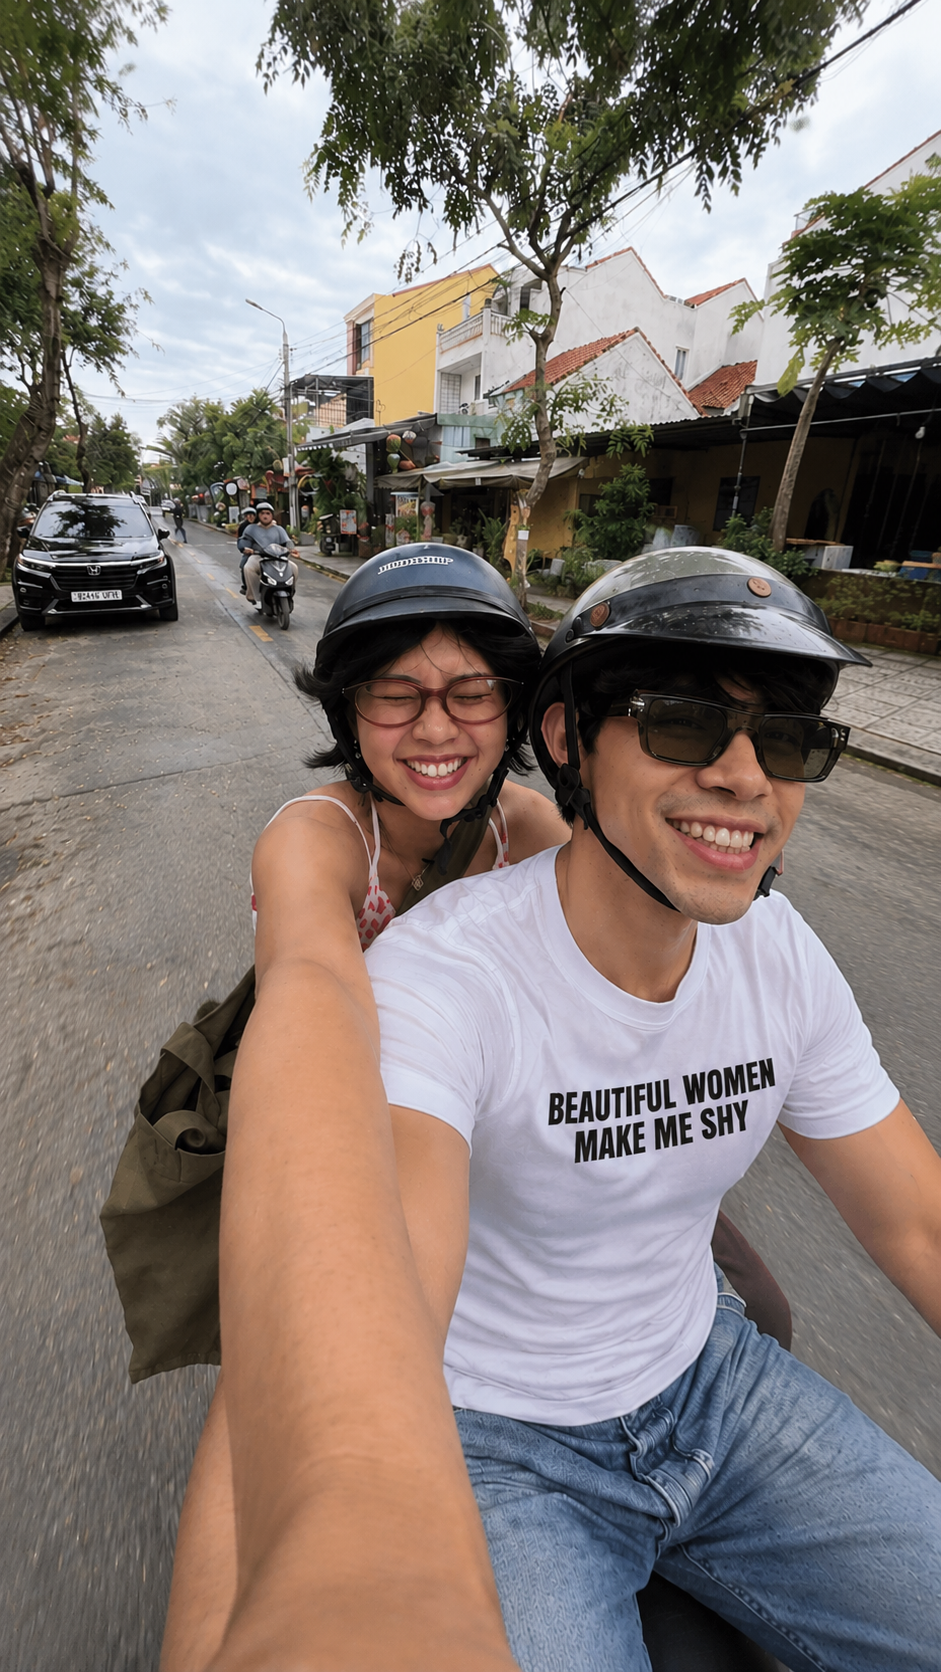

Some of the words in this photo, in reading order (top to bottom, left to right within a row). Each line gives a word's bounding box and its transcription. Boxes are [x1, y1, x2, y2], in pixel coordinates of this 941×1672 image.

[548, 1079, 676, 1126] BEAUTIFUL
[682, 1058, 776, 1105] WOMEN
[574, 1121, 646, 1163] MAKE
[654, 1112, 693, 1150] ME
[700, 1099, 749, 1140] SHY
